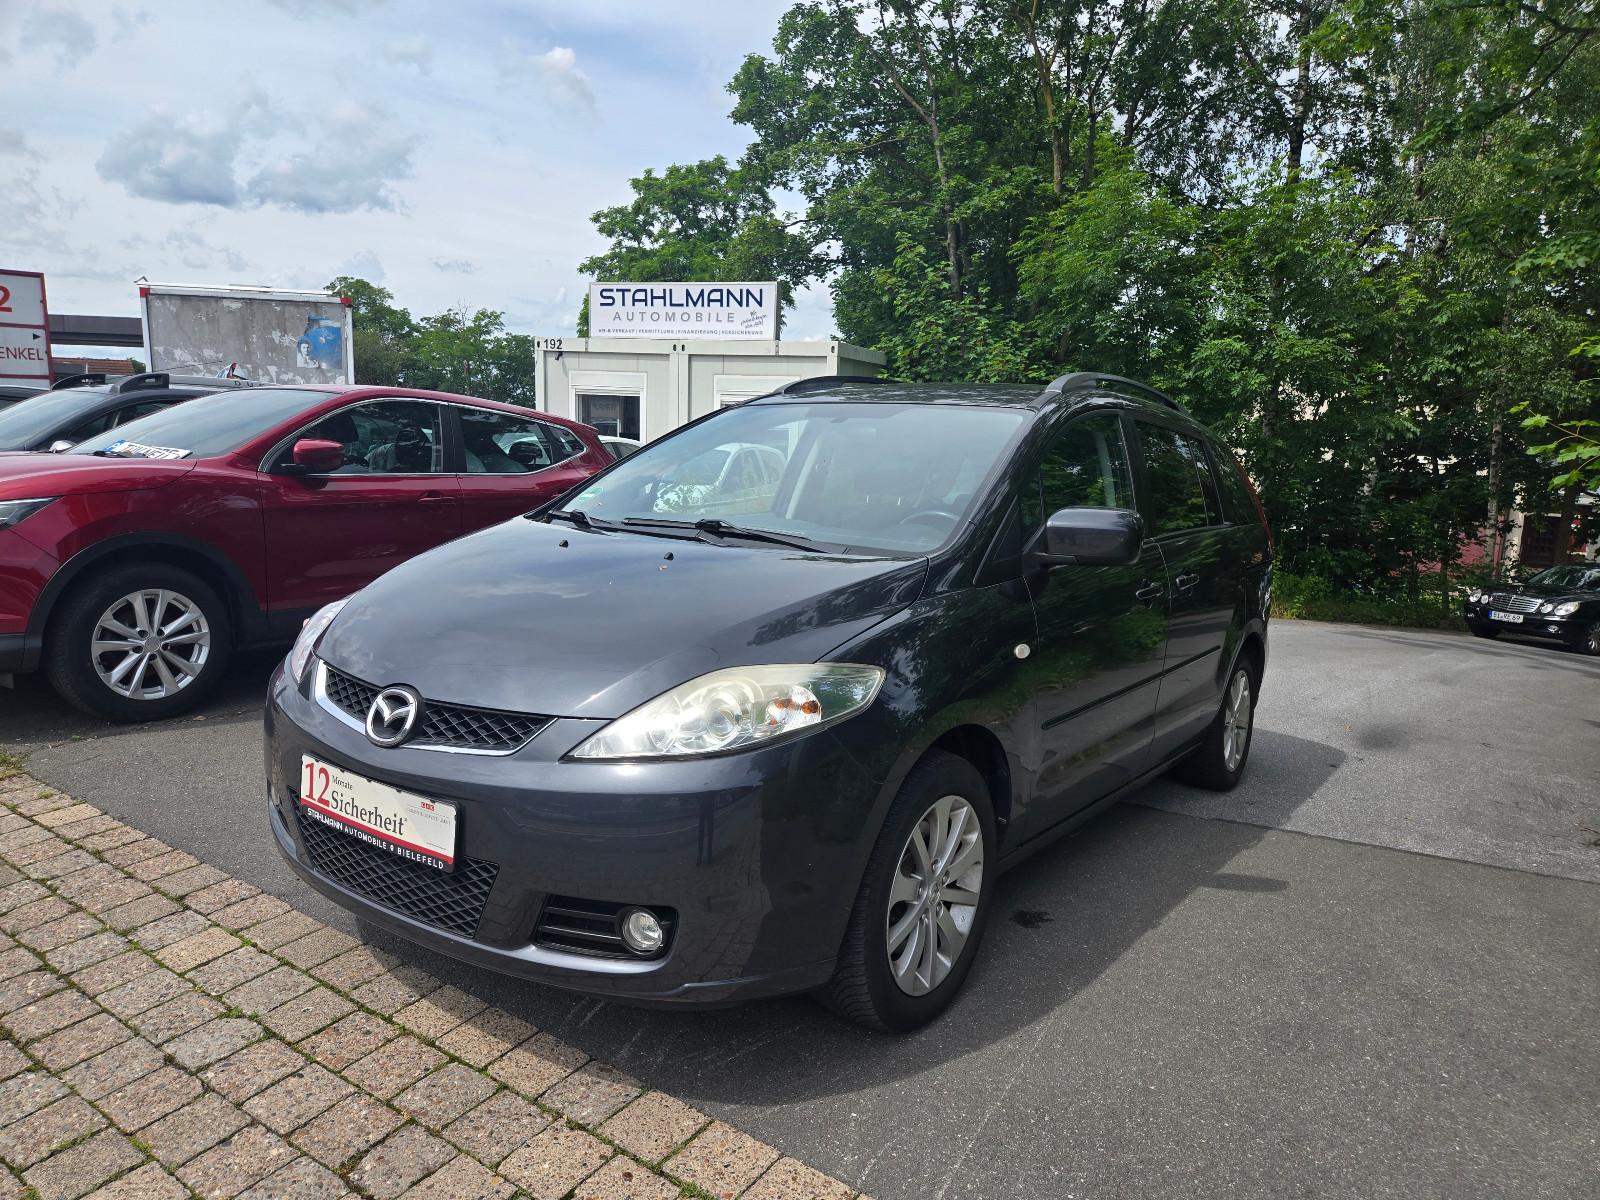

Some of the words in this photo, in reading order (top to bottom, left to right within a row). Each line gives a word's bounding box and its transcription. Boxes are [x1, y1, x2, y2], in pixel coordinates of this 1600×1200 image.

[599, 288, 763, 308] STAHLMANN
[613, 311, 735, 323] AUTOMOBILE
[543, 338, 563, 350] 192
[305, 762, 331, 808] 12
[332, 774, 353, 791] Monate
[307, 807, 343, 831] STAHLMANN
[344, 824, 387, 850] AUTOMOBILE
[397, 847, 444, 870] BIELEFELD
